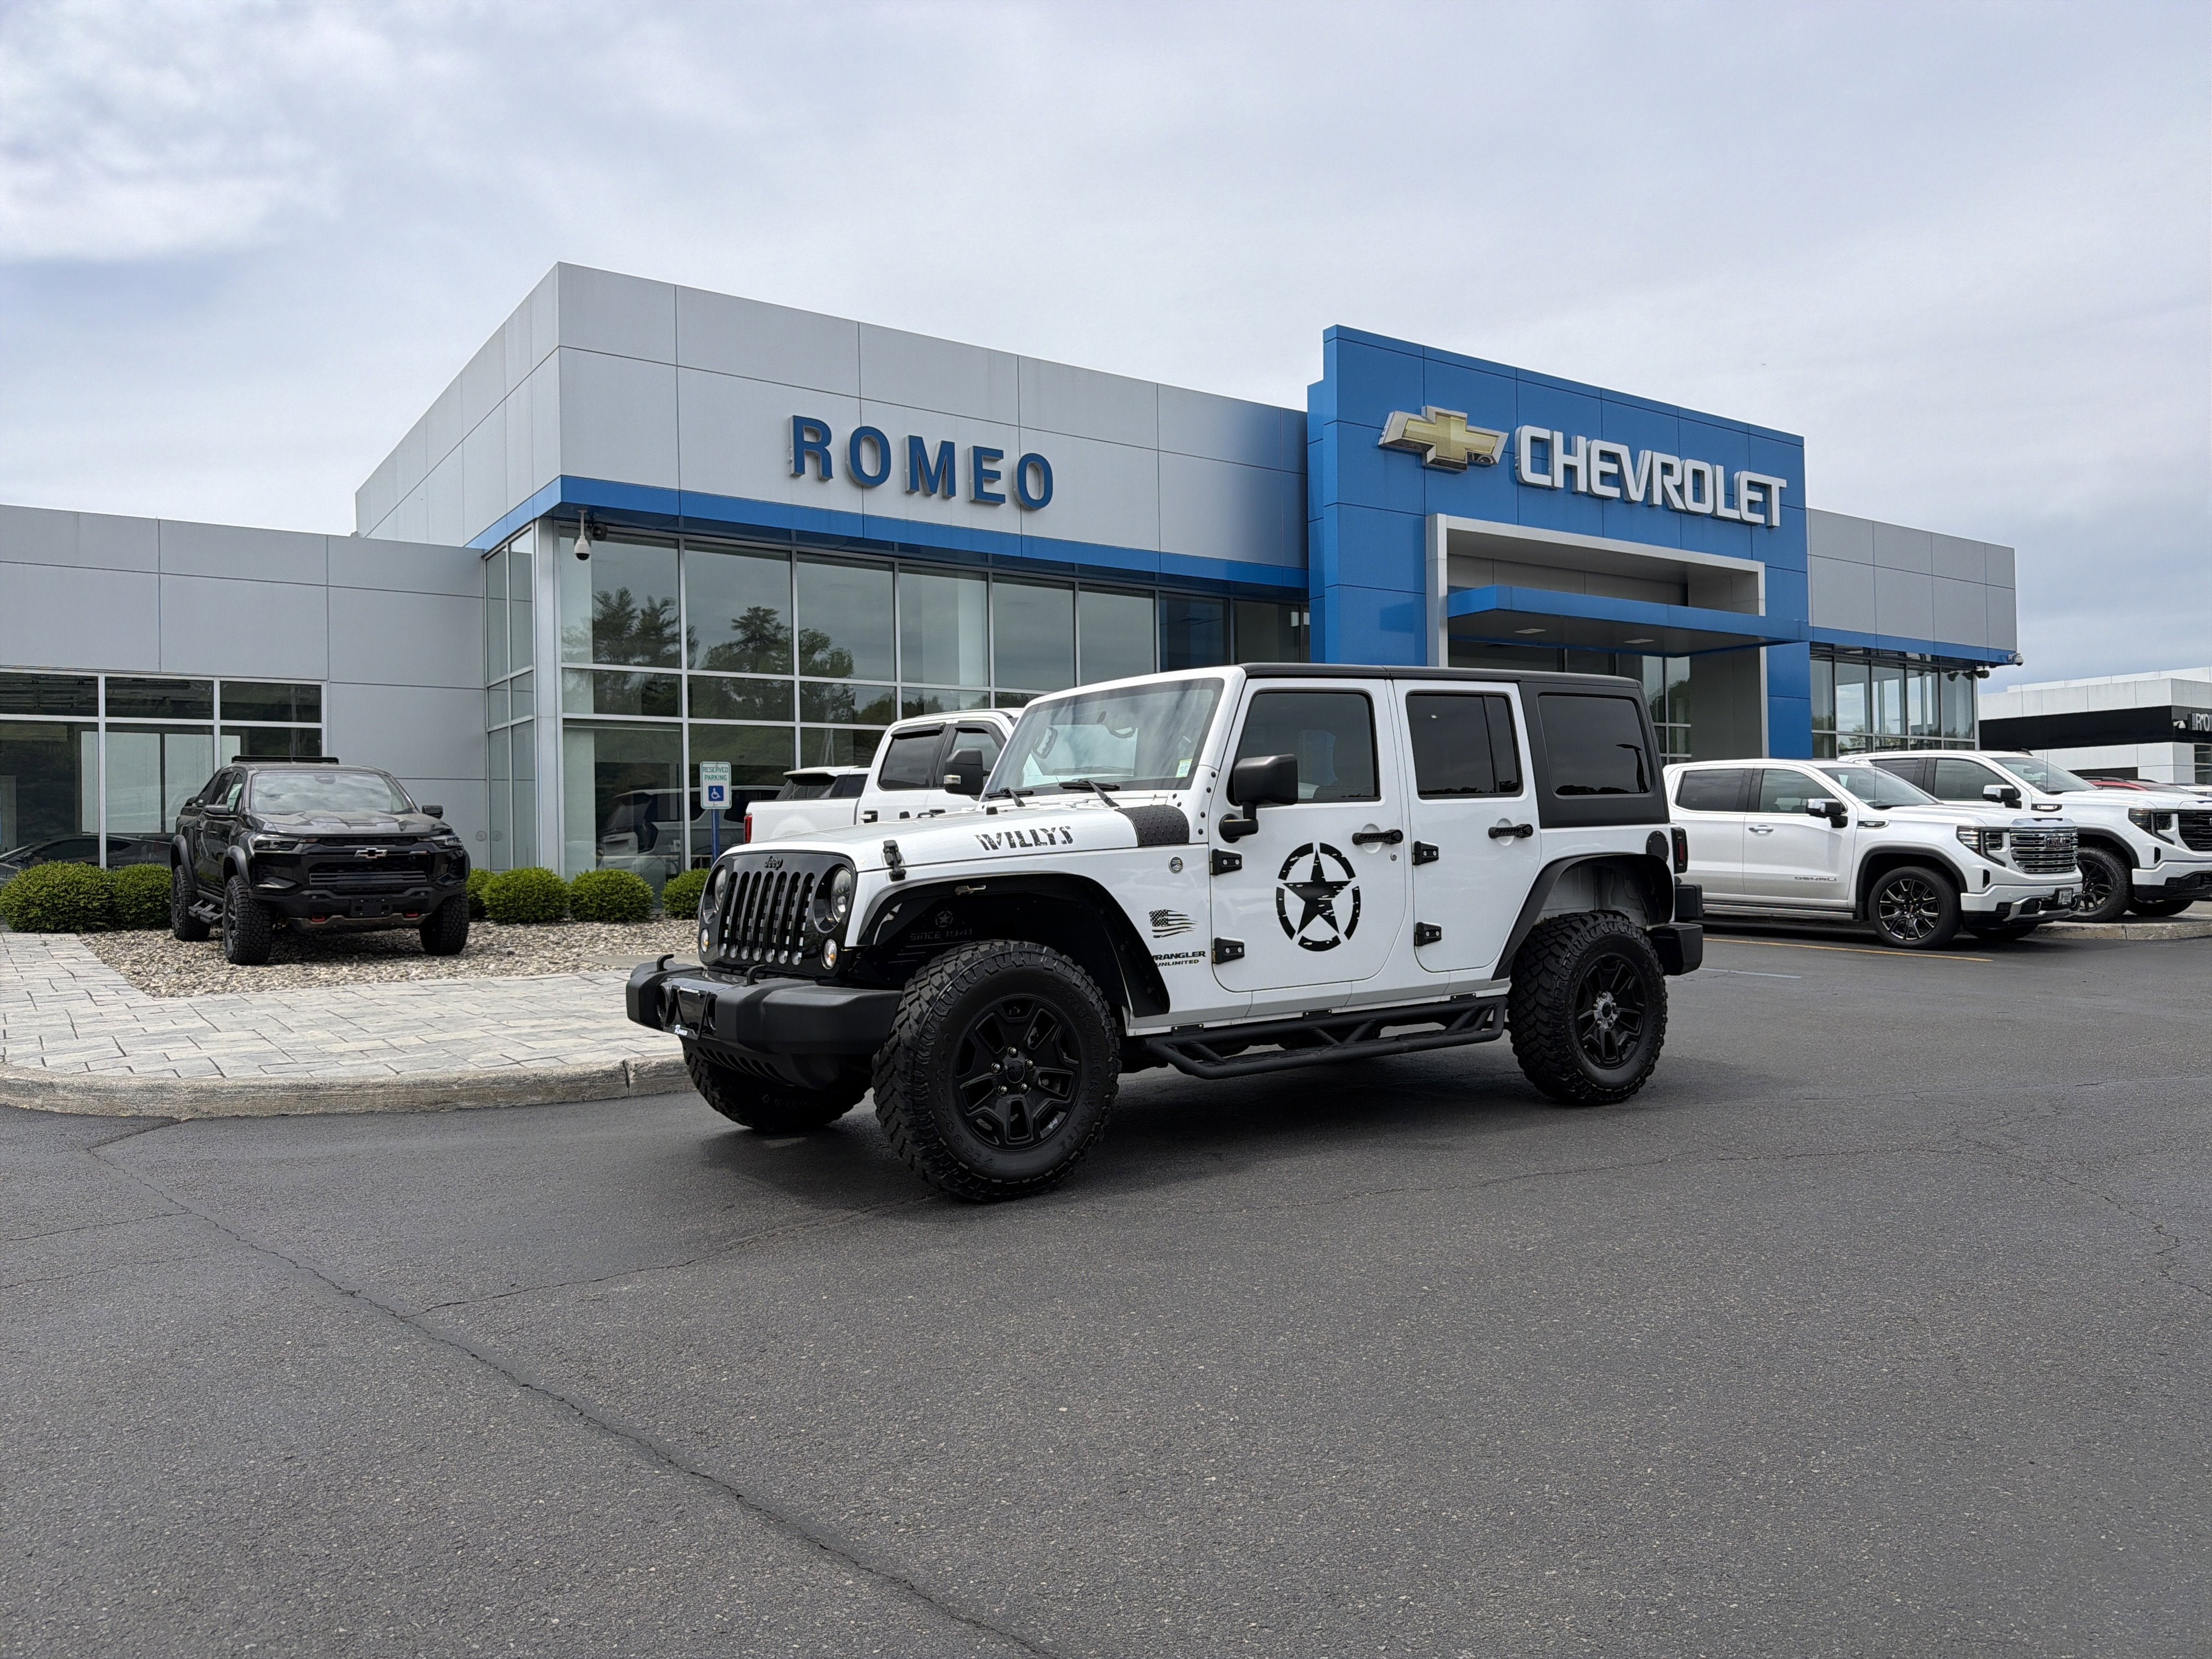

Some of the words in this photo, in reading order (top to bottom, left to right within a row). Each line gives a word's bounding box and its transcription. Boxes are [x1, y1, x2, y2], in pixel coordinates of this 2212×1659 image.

[789, 415, 1053, 510] ROMEO
[1515, 425, 1787, 527] CHEVROLET
[764, 856, 783, 870] Jeep
[974, 826, 1073, 851] WILLYS
